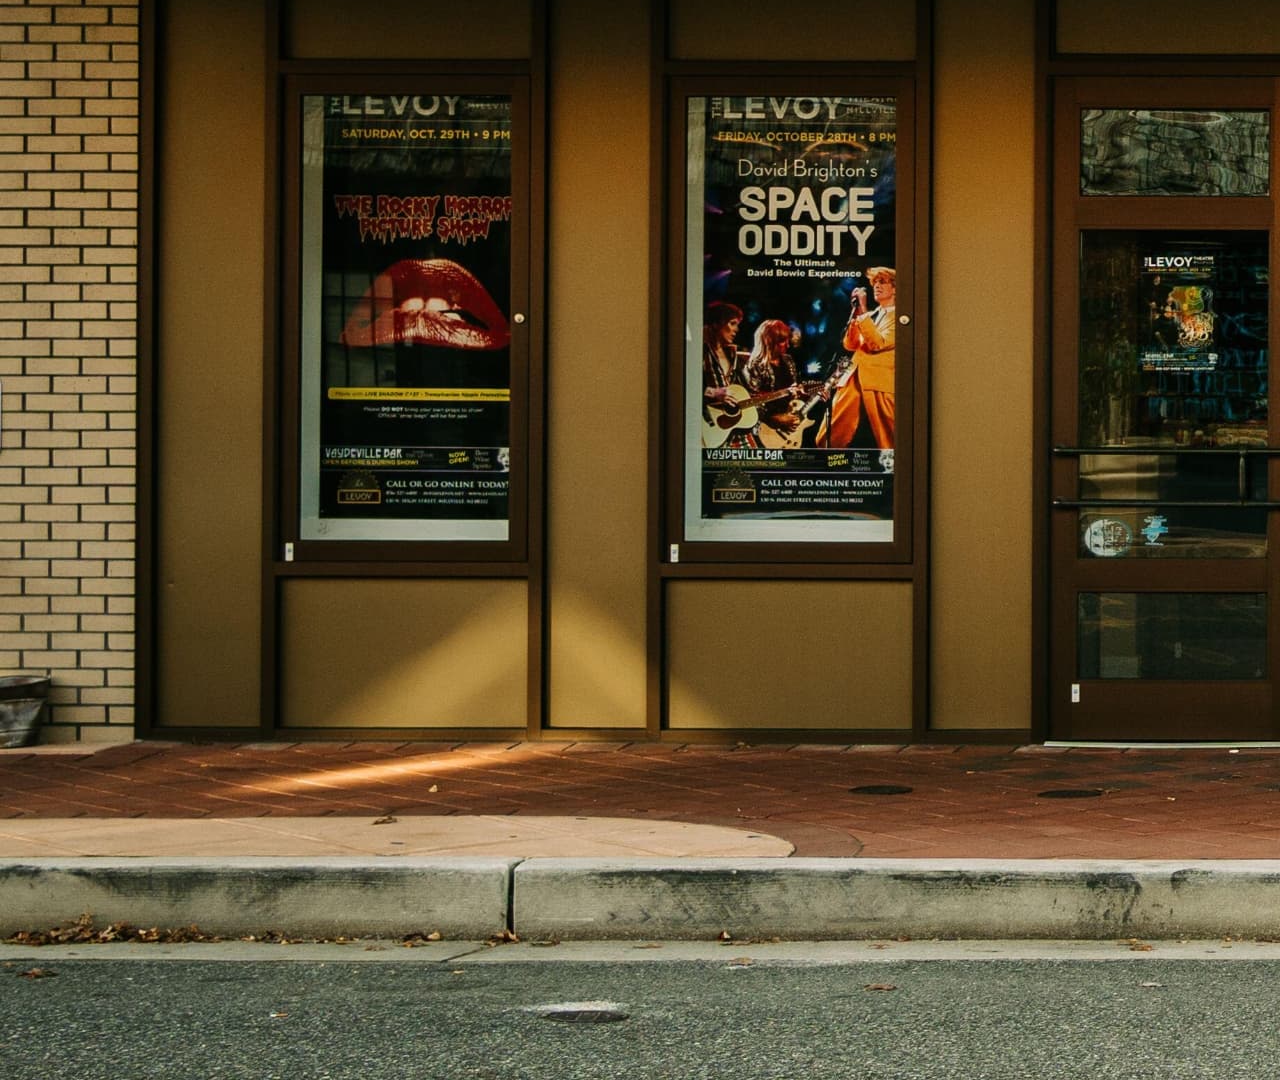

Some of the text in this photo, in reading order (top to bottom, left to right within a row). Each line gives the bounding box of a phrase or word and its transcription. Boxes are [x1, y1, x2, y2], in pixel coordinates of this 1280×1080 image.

[343, 96, 461, 116] LEVOY
[724, 97, 842, 119] LEVOY
[342, 129, 511, 140] SATURDAY, OCT. 29TH 9 PM
[718, 132, 896, 142] FRIDAY, OCTOBER 28TH 8 PM
[738, 160, 877, 182] David Brighton's
[335, 195, 372, 219] THE
[377, 195, 441, 220] ROCKY
[738, 187, 875, 222] SPACE
[358, 218, 491, 247] PICTURE SHOW
[738, 225, 875, 256] ODDITY
[773, 259, 836, 267] The Ultimate
[1148, 256, 1192, 267] LEVOY
[747, 269, 862, 278] David Bowie Experience
[827, 459, 849, 467] OPEN!
[386, 480, 510, 488] CALL OR GO ONLINE TODAY!
[761, 479, 884, 488] CALL OR GO ONLINE TODAY!
[720, 492, 748, 501] LEVOY
